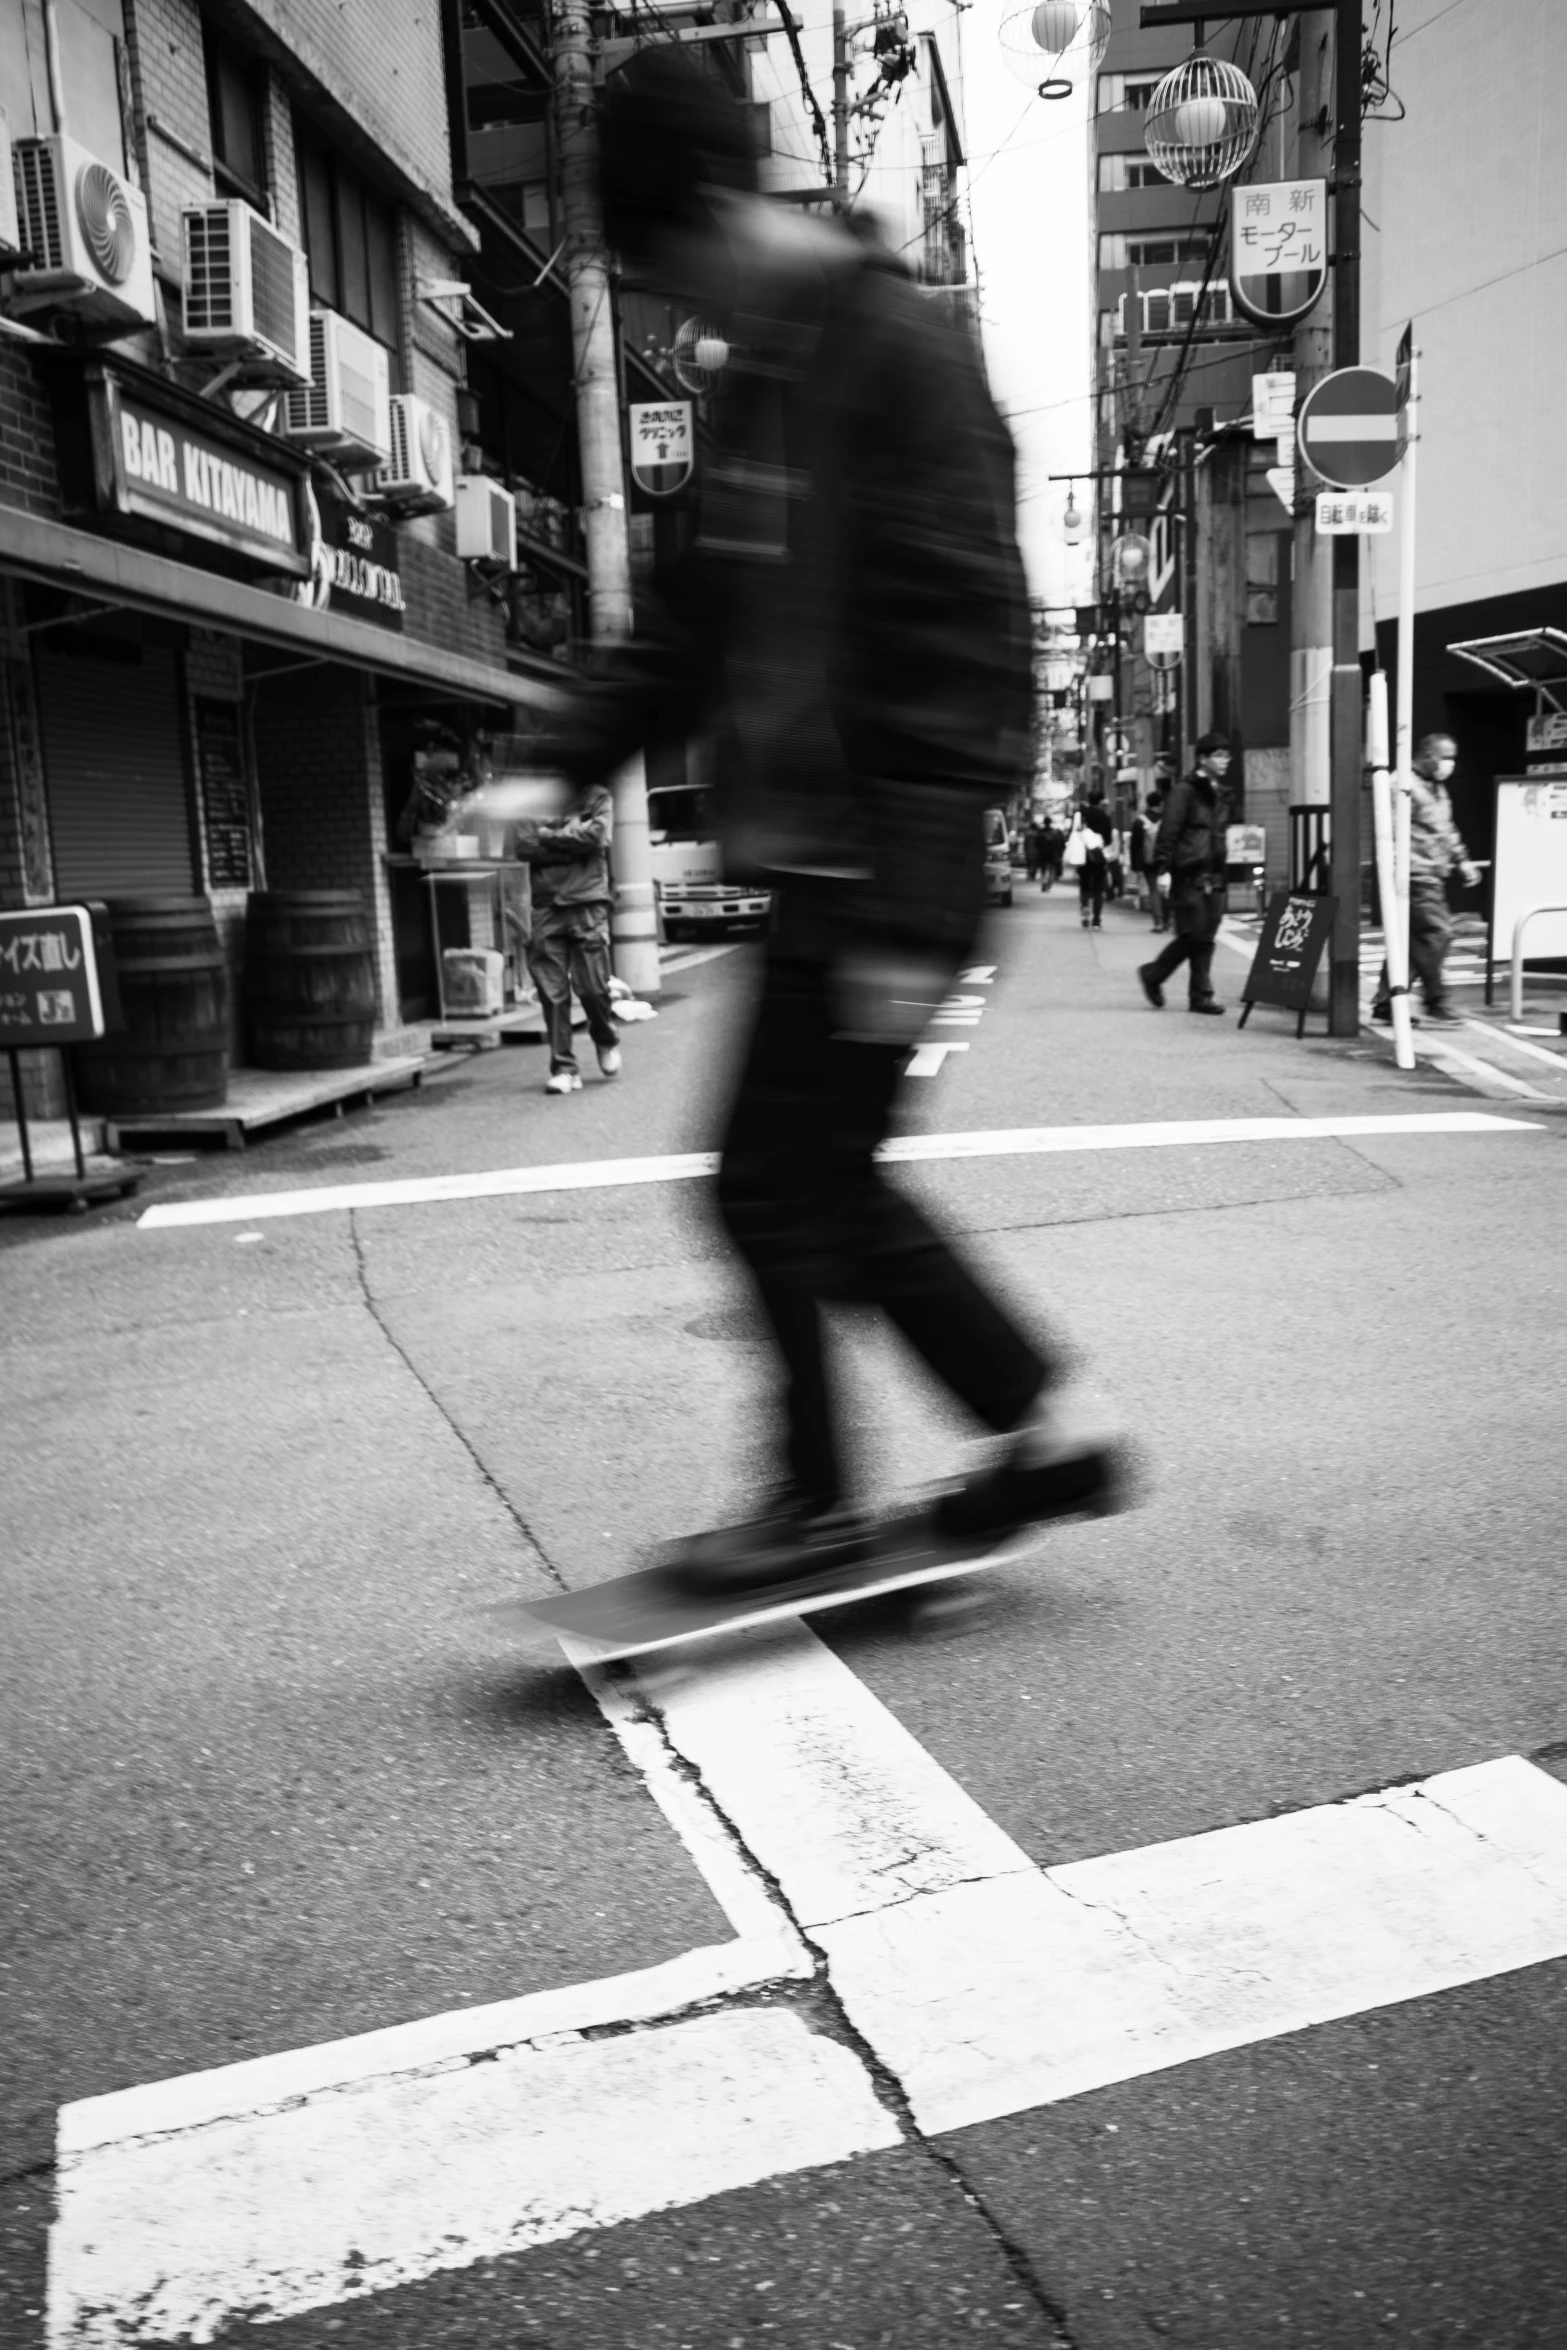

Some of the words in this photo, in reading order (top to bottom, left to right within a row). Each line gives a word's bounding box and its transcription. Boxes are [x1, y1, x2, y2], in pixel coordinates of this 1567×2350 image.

[1245, 193, 1271, 217] 南
[1289, 188, 1315, 213] 新
[1240, 221, 1313, 246] モーター
[1264, 243, 1321, 268] プール
[120, 410, 178, 494] BAR
[182, 441, 292, 545] KITAYAMA
[0, 930, 81, 974] イズ直し
